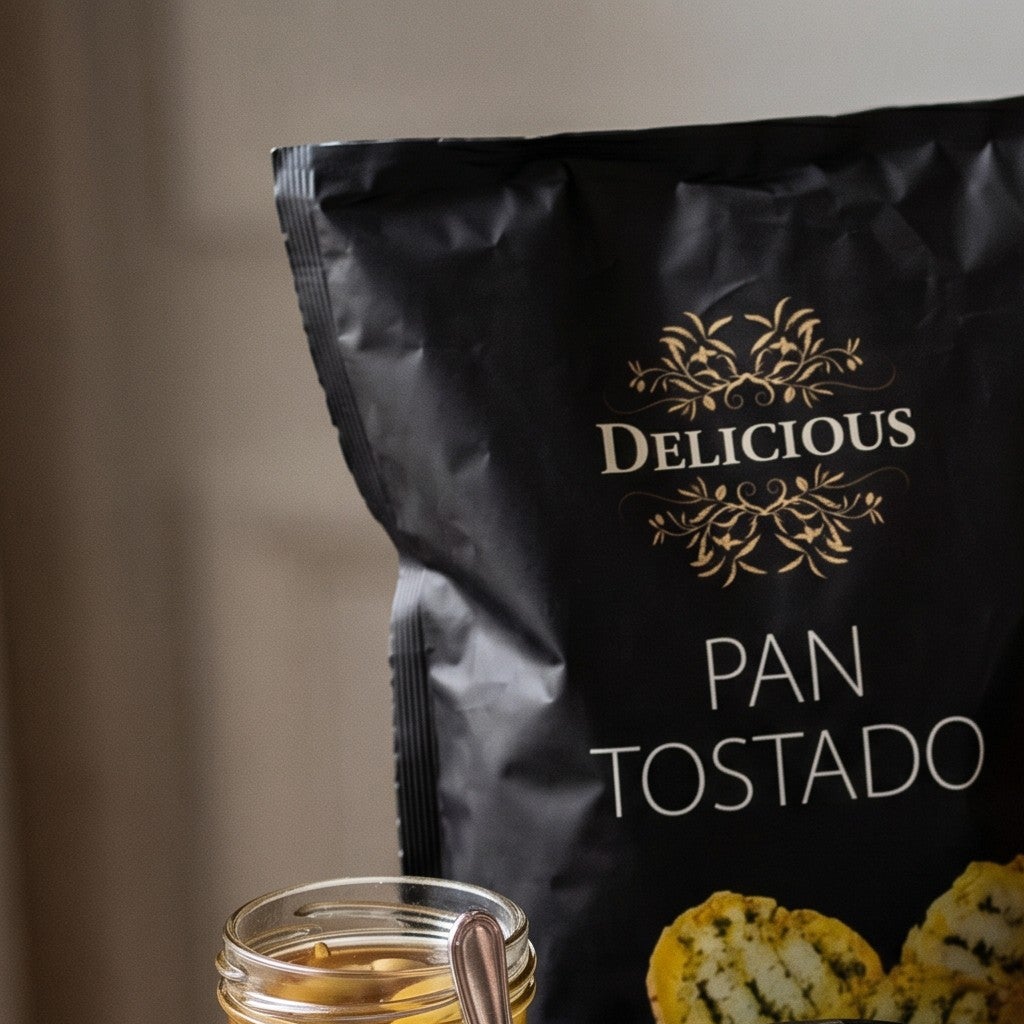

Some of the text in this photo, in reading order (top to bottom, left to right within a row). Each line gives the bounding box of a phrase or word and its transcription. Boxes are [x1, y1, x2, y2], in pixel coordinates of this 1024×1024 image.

[596, 407, 917, 476] DELICIOUS
[705, 625, 864, 711] PAN
[589, 715, 986, 818] TOSTADO
